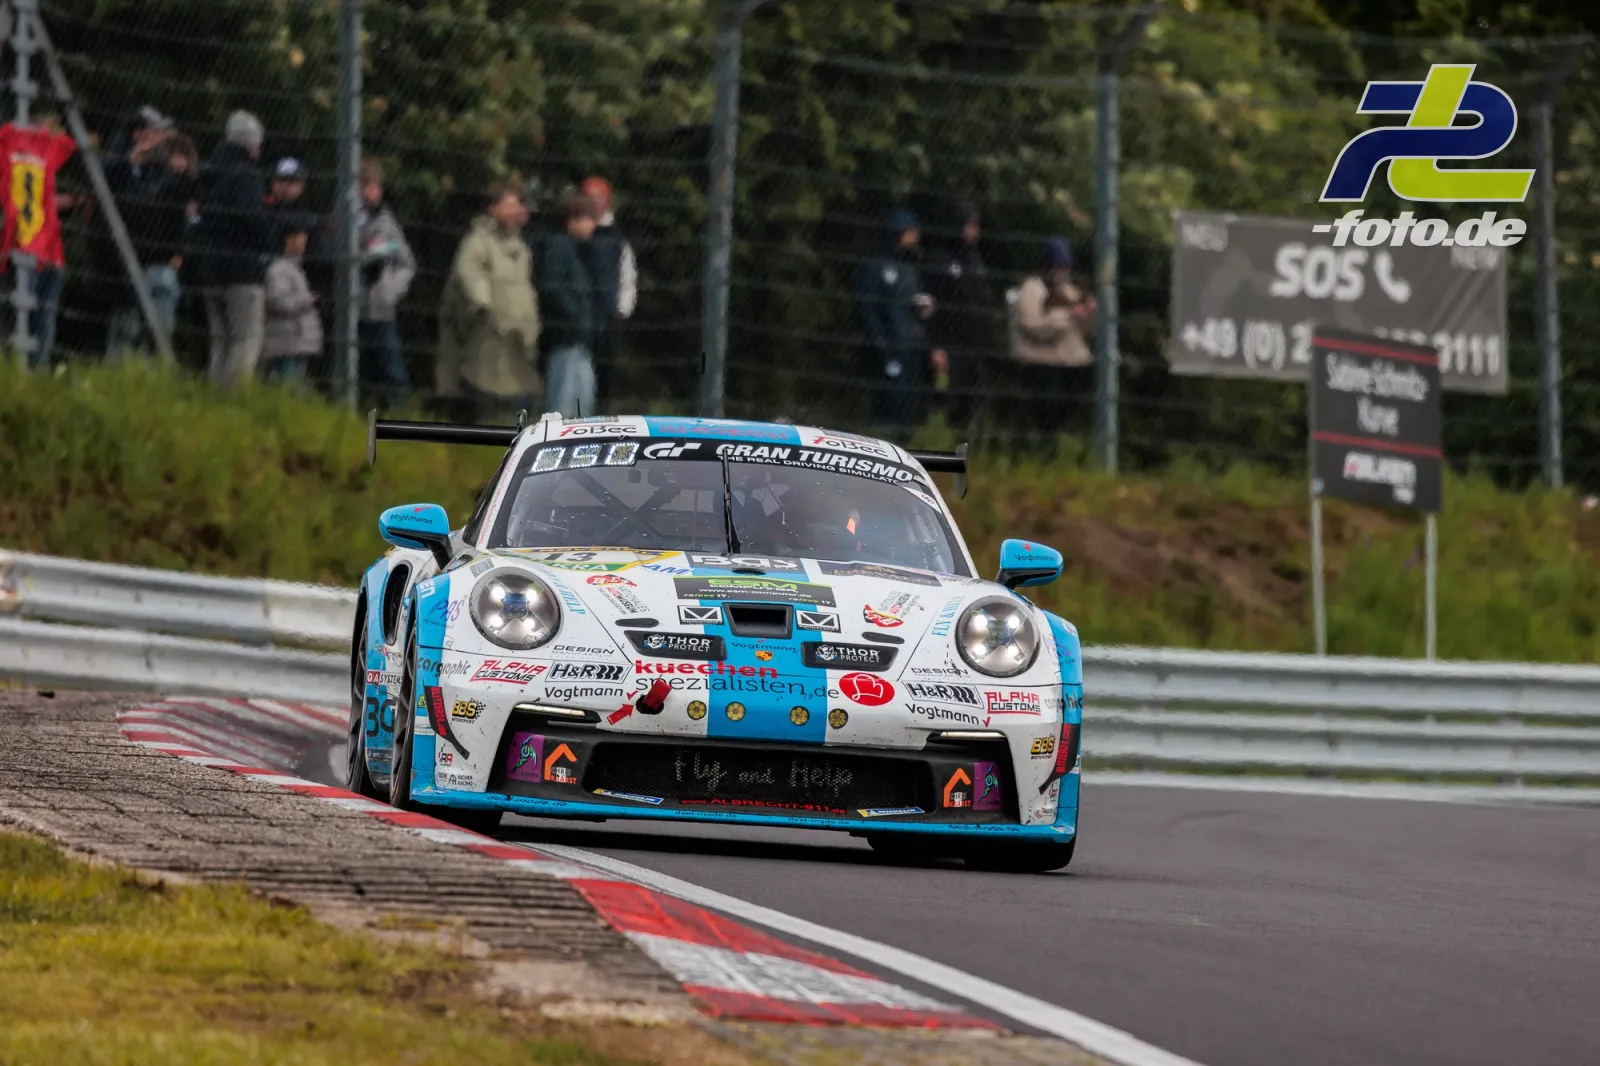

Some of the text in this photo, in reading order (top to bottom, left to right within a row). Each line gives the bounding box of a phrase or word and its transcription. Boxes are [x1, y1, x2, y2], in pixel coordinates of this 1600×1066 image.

[1269, 242, 1368, 301] SOS
[1182, 316, 1238, 359] +49
[1241, 319, 1287, 371] (0)
[716, 444, 912, 482] GRAN TURISMO
[747, 456, 781, 465] REAL
[784, 460, 836, 472] DRIVING
[390, 513, 433, 525] Vogtmann
[667, 636, 711, 647] THOR
[668, 643, 711, 653] PROTECT
[730, 641, 796, 652] Vogtmann
[553, 644, 615, 655] DESIGN
[836, 647, 880, 658] THOR
[840, 655, 880, 663] PROTECT
[483, 660, 549, 675] ALPHA
[635, 660, 778, 679] kuechen
[911, 667, 969, 675] DESIGN
[475, 670, 537, 683] CUSTOMS
[544, 685, 624, 701] Vogtmann
[987, 692, 1041, 704] ALPHA
[452, 700, 477, 719] BBS
[990, 702, 1041, 713] CUSTOMS
[905, 703, 980, 726] Vogtmann
[1031, 737, 1056, 755] BBS
